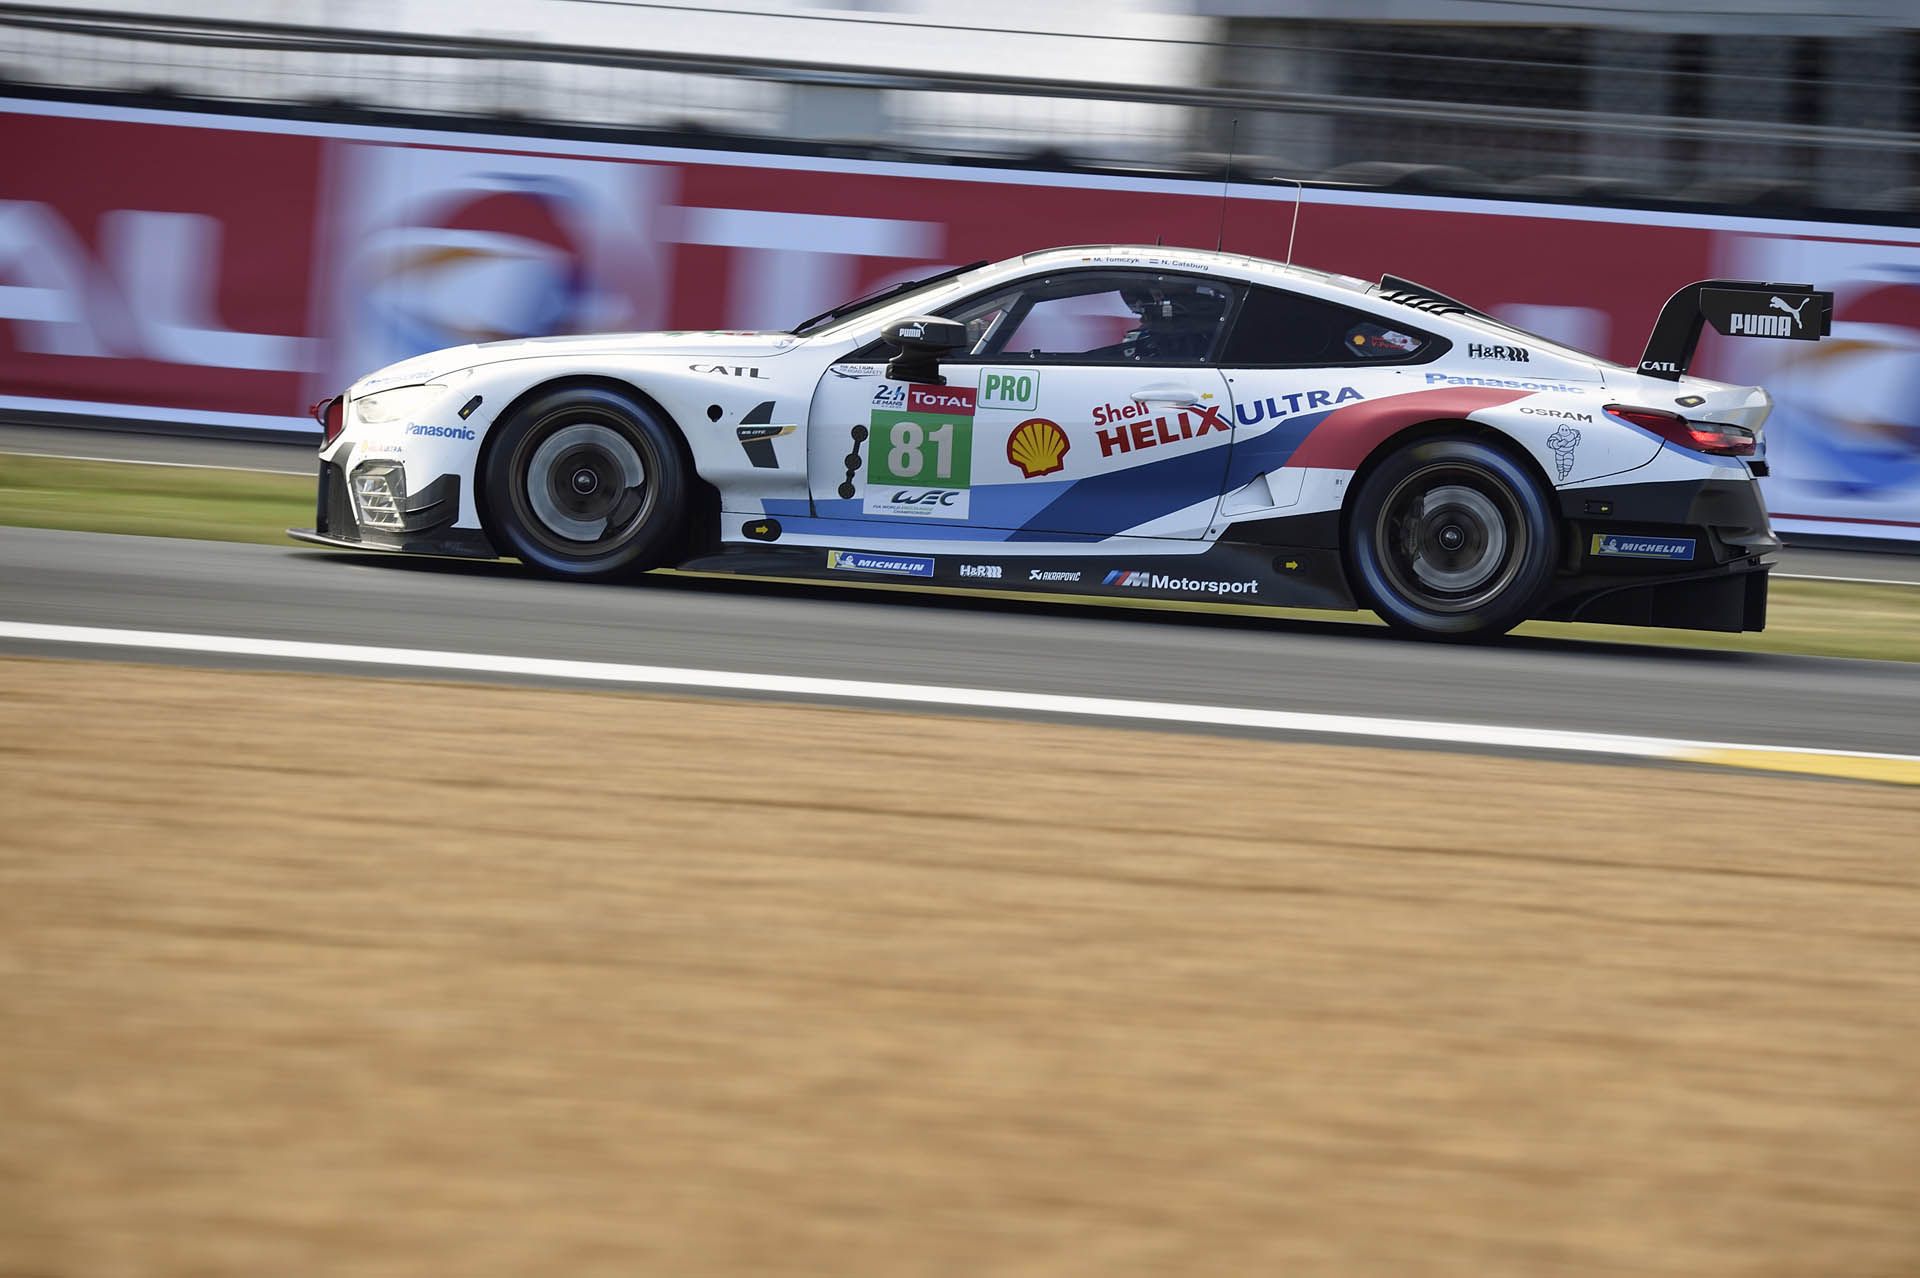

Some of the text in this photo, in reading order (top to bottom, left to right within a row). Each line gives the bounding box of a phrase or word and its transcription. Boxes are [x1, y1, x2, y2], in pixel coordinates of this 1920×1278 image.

[1730, 313, 1792, 337] PUMA
[689, 364, 770, 380] CATL
[1641, 360, 1680, 373] CATL
[985, 374, 1032, 402] PRO
[1425, 372, 1585, 395] Panasonic
[911, 391, 973, 408] TOTAL
[1235, 386, 1365, 425] ULTRA
[1092, 400, 1150, 426] Shell
[1519, 407, 1593, 424] OSRAM
[405, 422, 476, 441] Panasonic
[1095, 405, 1231, 458] HELIX
[887, 421, 954, 479] 81
[891, 489, 960, 506] WEC
[1620, 542, 1686, 554] MICHELIN
[856, 559, 925, 572] MICHELIN
[1151, 574, 1259, 595] Motorsport
